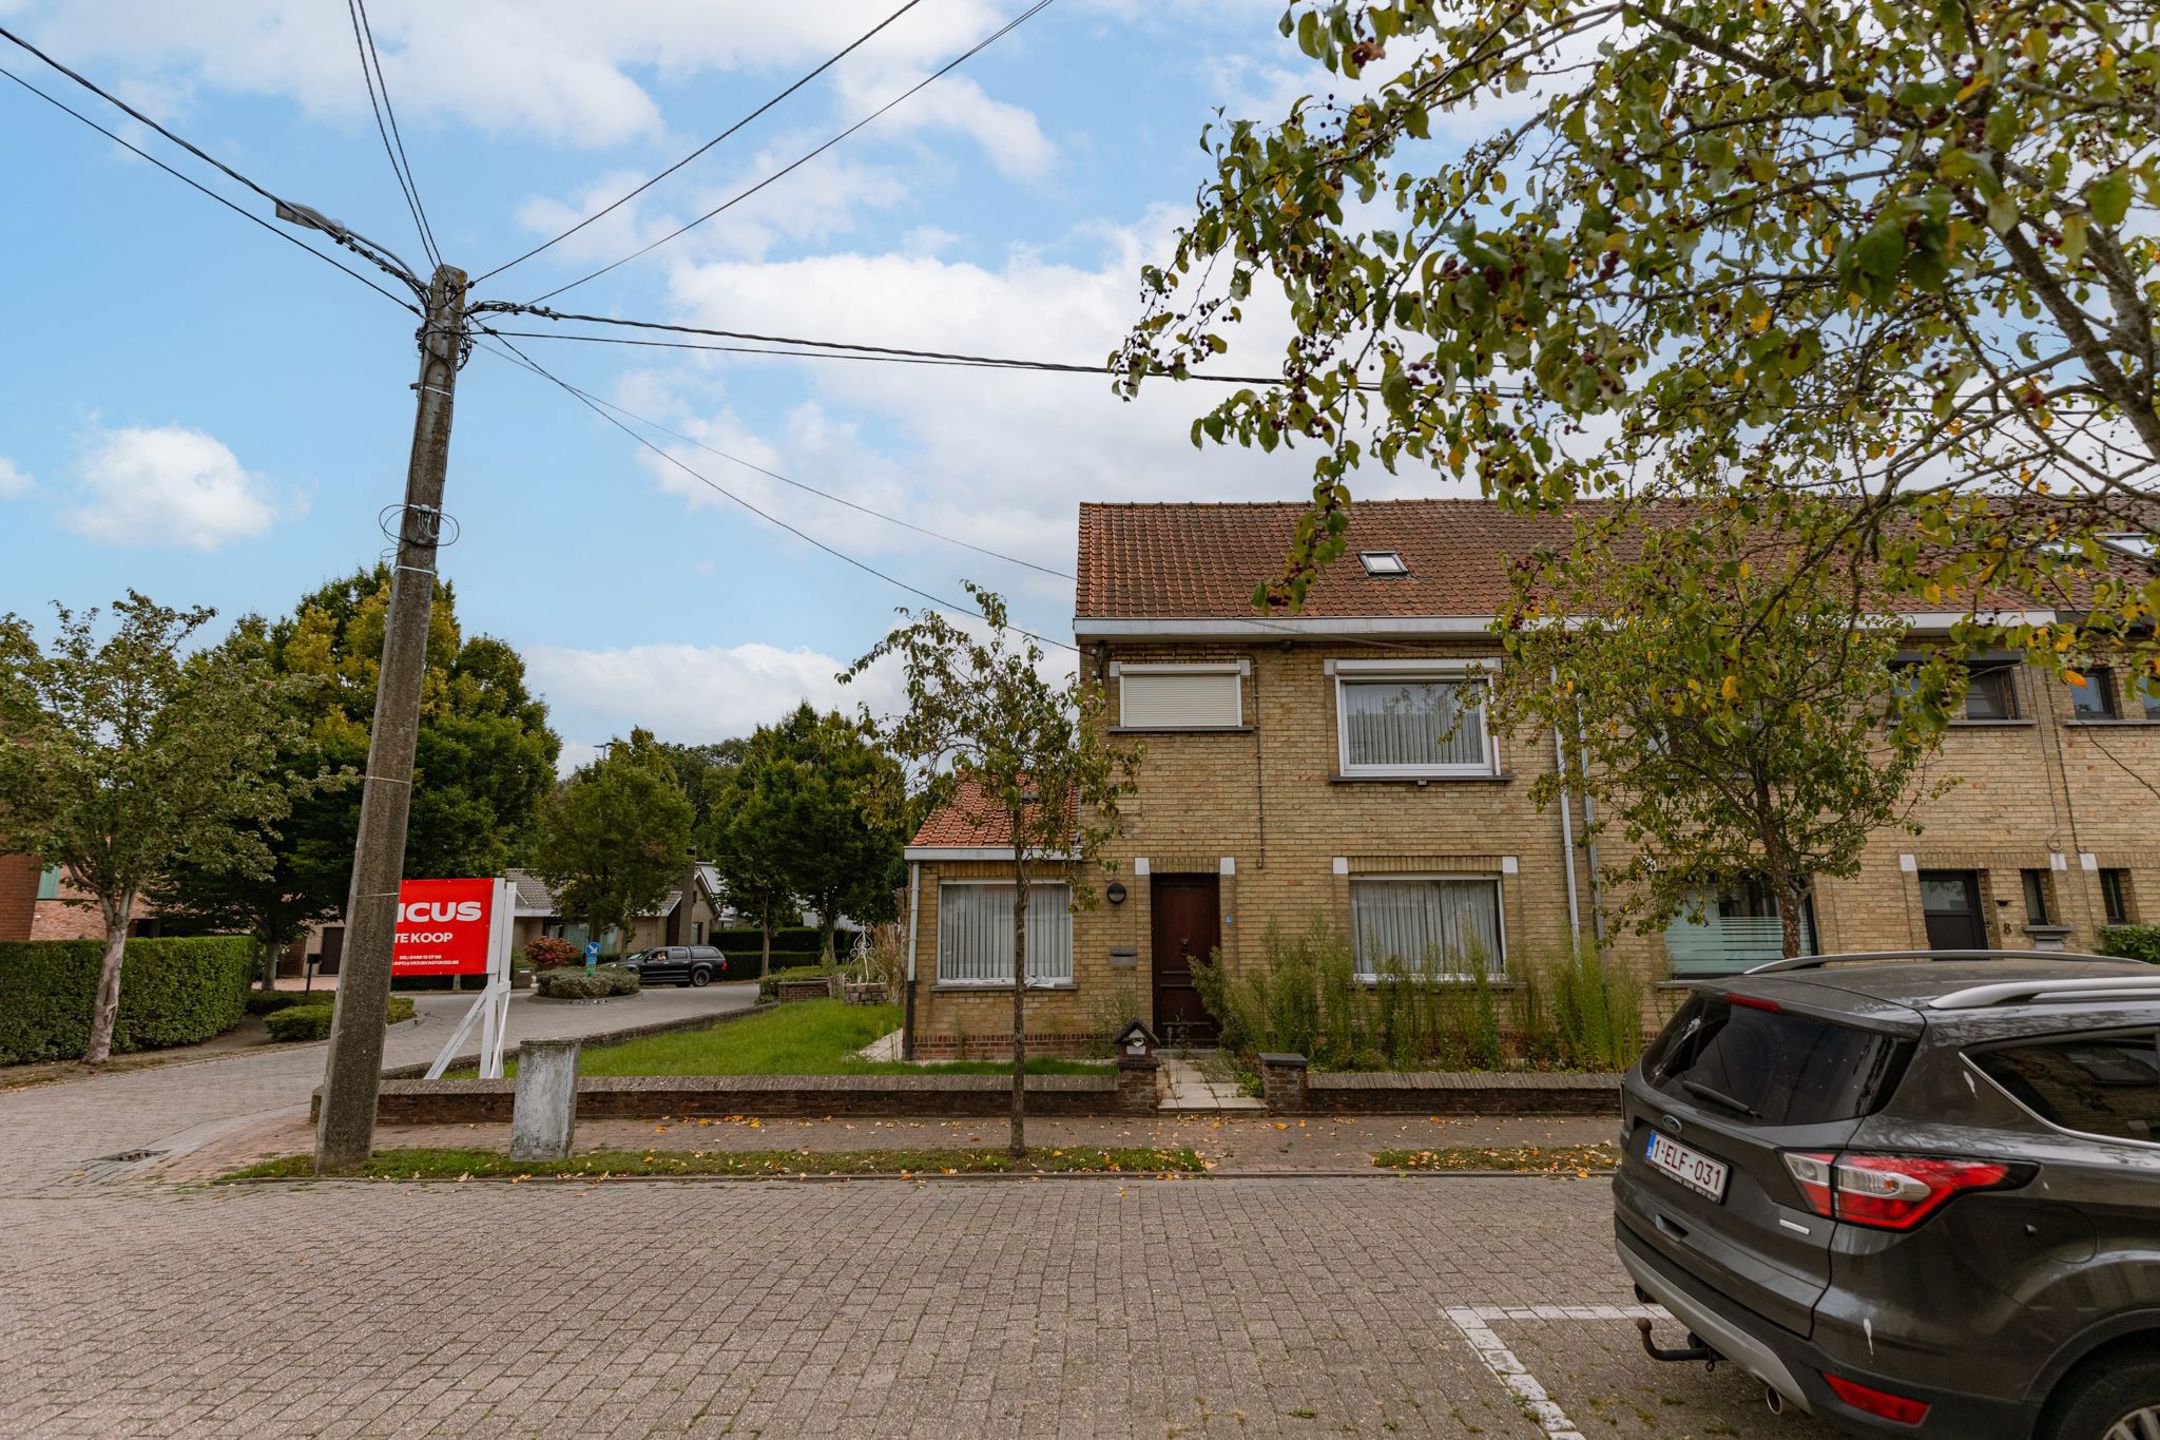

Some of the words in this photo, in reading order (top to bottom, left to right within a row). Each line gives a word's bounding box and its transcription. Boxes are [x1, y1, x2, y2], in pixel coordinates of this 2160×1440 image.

[397, 901, 482, 922] ICUS
[395, 933, 409, 943] TE
[410, 932, 453, 943] KOOP
